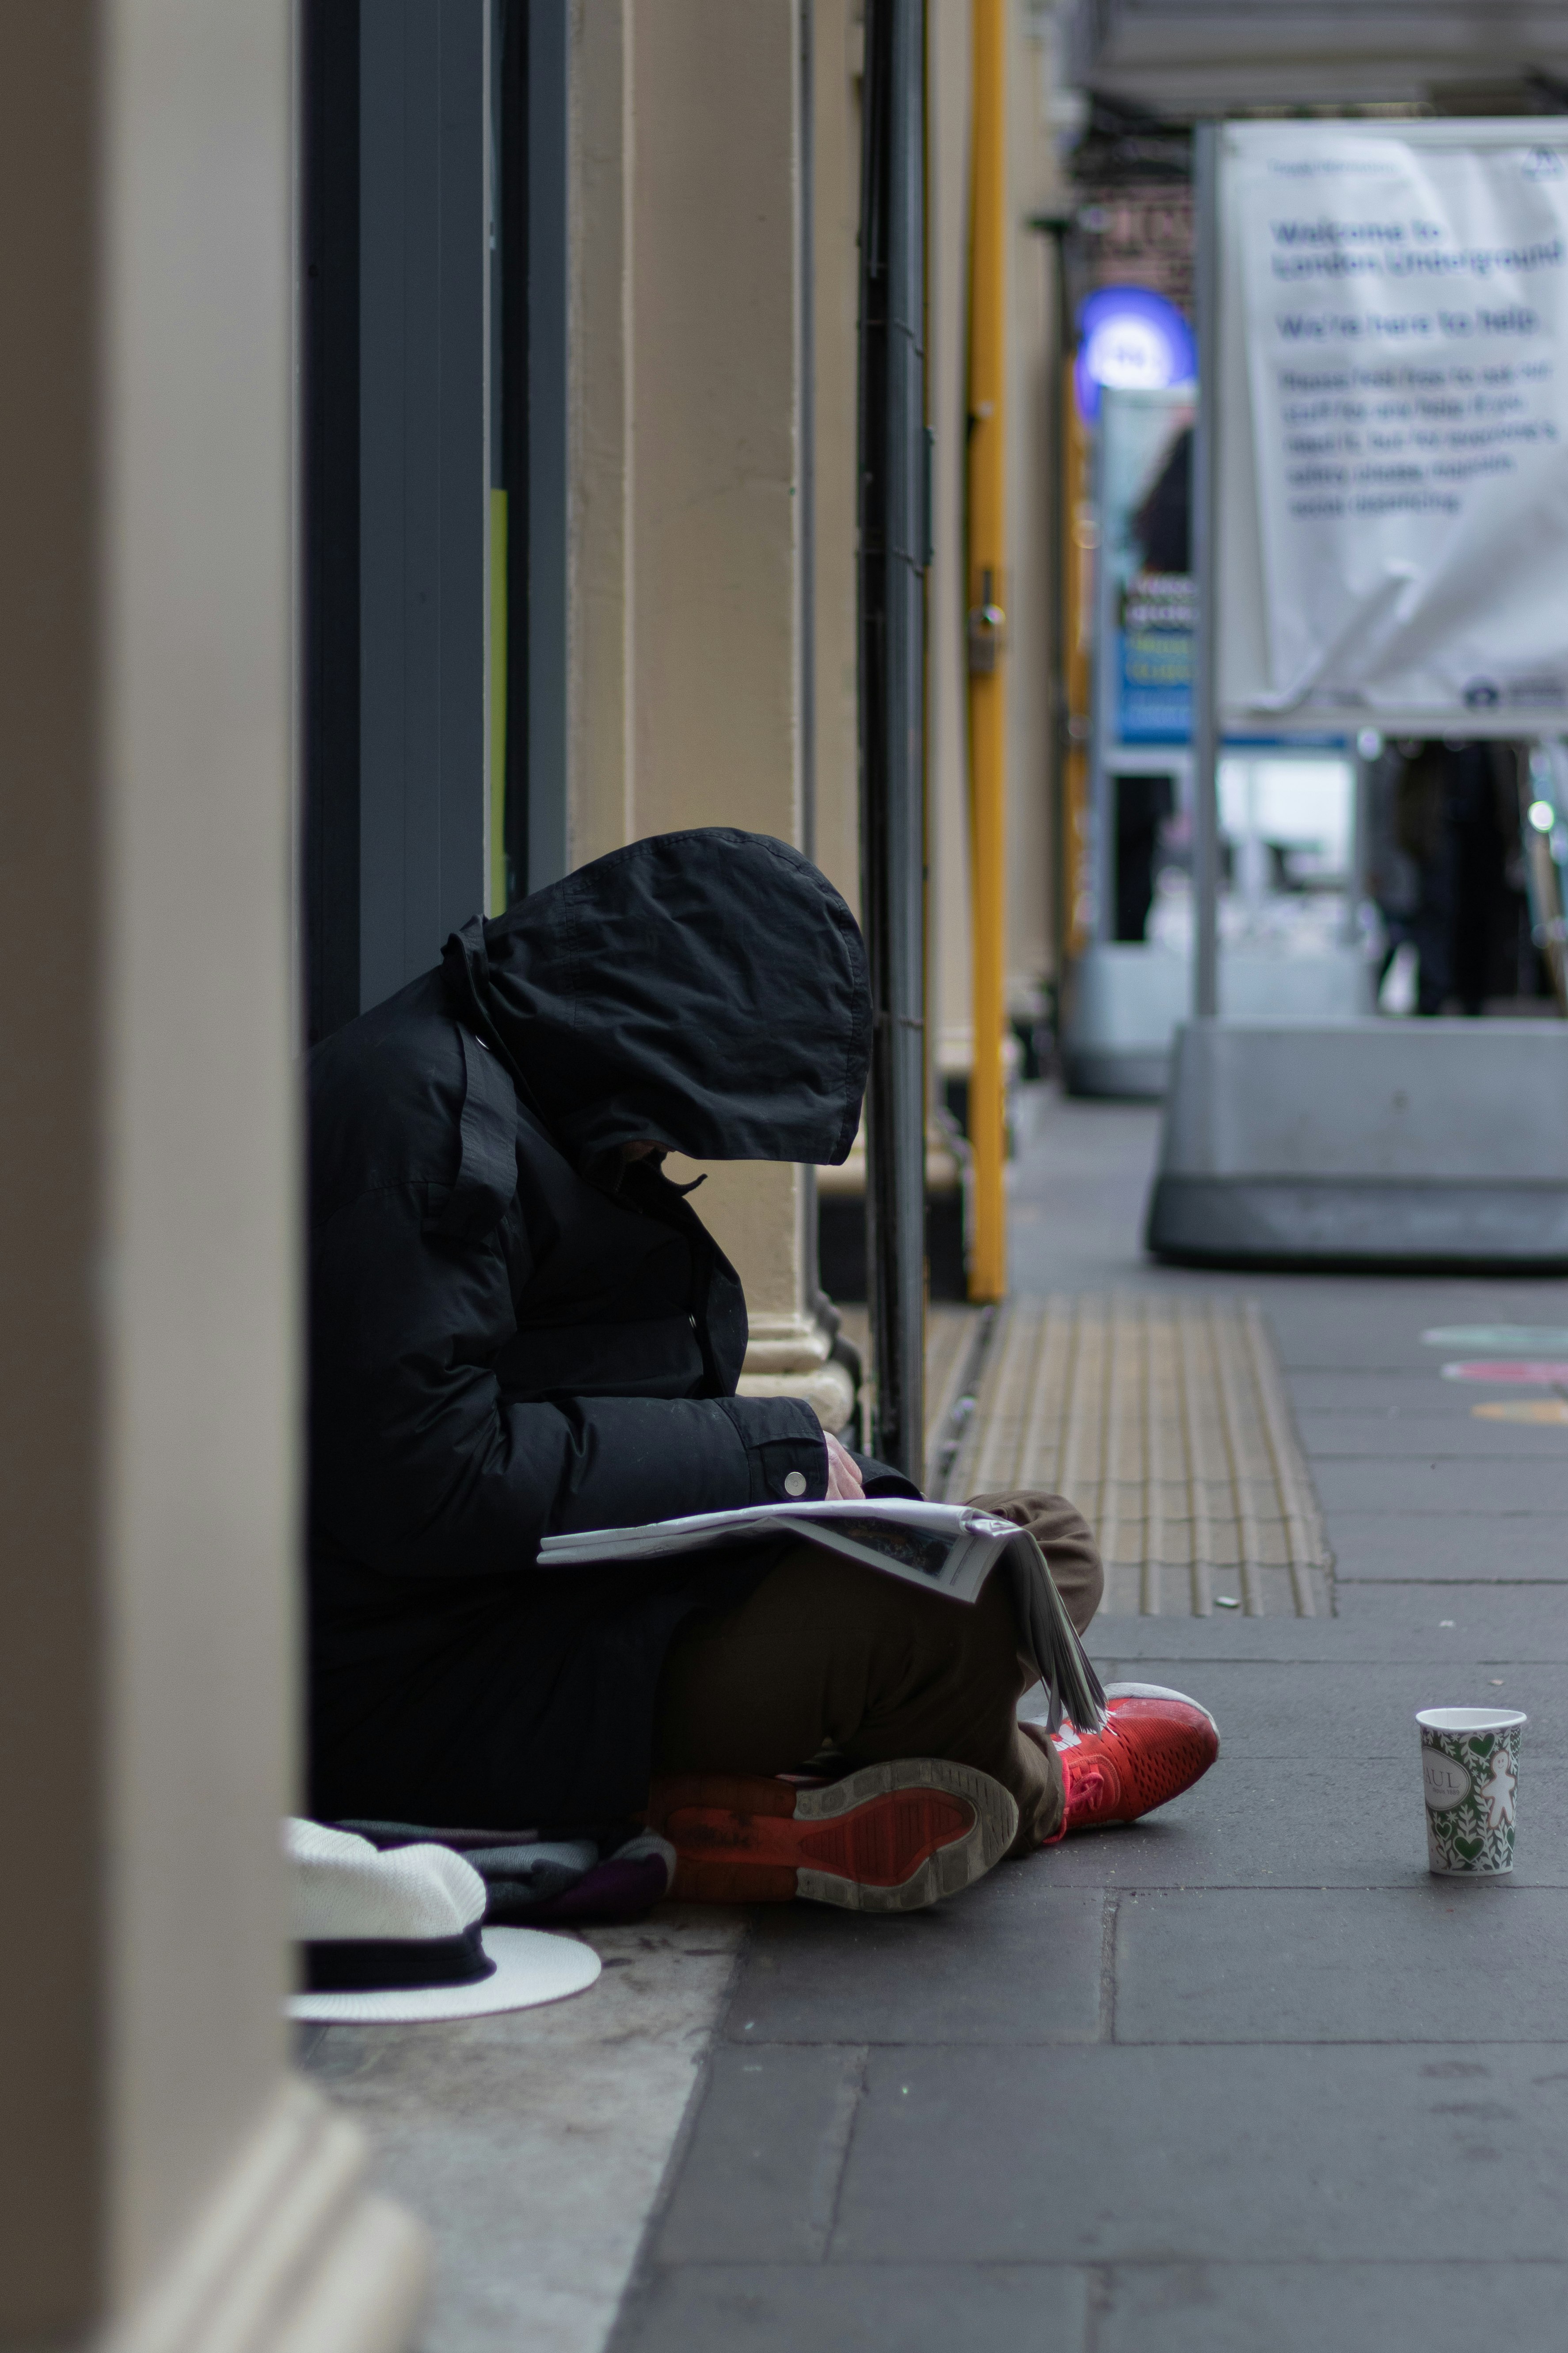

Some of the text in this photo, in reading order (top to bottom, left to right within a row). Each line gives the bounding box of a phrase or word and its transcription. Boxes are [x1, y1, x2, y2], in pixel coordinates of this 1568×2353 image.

[1273, 217, 1446, 248] Welcome to
[1274, 238, 1566, 279] London Underground
[1278, 307, 1540, 341] We're here to help
[1282, 369, 1351, 393] Please
[1354, 367, 1399, 392] feel
[1402, 366, 1448, 390] free
[1452, 366, 1476, 388] to
[1481, 365, 1516, 388] ask
[1283, 400, 1334, 426] staff
[1338, 400, 1368, 423] for
[1419, 398, 1466, 423] help
[1423, 1767, 1460, 1789] AUL
